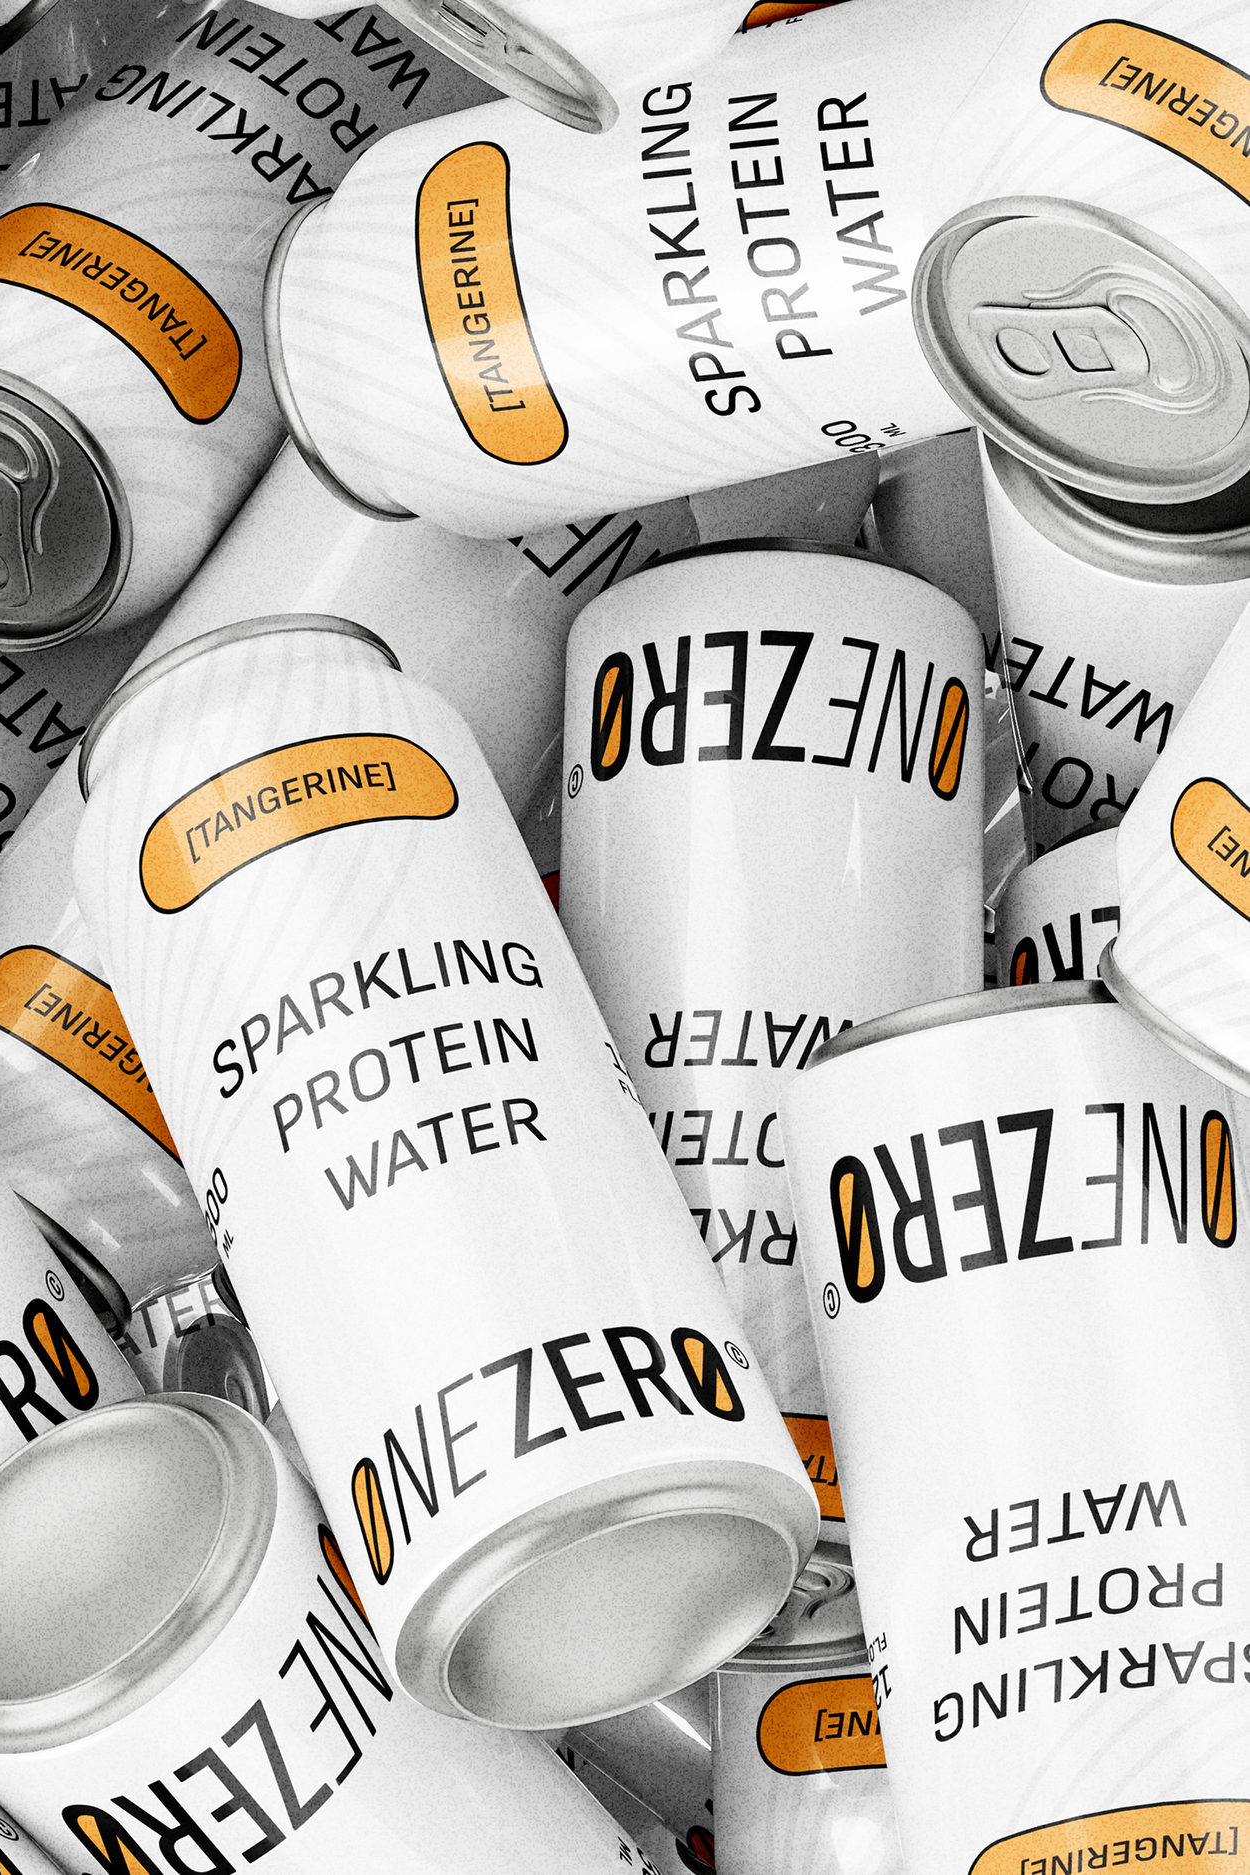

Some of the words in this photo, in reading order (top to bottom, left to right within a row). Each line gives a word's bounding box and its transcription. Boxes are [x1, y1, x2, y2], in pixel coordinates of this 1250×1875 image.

[175, 8, 380, 155] ROTEIN
[313, 5, 431, 111] WAT
[1097, 56, 1250, 160] NGERINE]
[95, 63, 334, 205] ARKLING
[640, 81, 763, 417] SPARKLING
[728, 92, 834, 361] PROTEIN
[817, 91, 908, 316] WATER
[19, 230, 208, 362] [TANGERINE]
[447, 198, 527, 413] [TANGERINE]
[822, 420, 885, 454] 300
[881, 422, 907, 439] ML
[186, 761, 397, 864] [TANGERINE]
[24, 983, 155, 1094] GERINE]
[212, 939, 544, 1099] SPARKLING
[273, 1016, 540, 1154] PROTEIN
[324, 1097, 548, 1212] WATER
[222, 1230, 236, 1259] ML
[963, 1479, 1188, 1563] WATER
[953, 1561, 1224, 1654] PROTEIN
